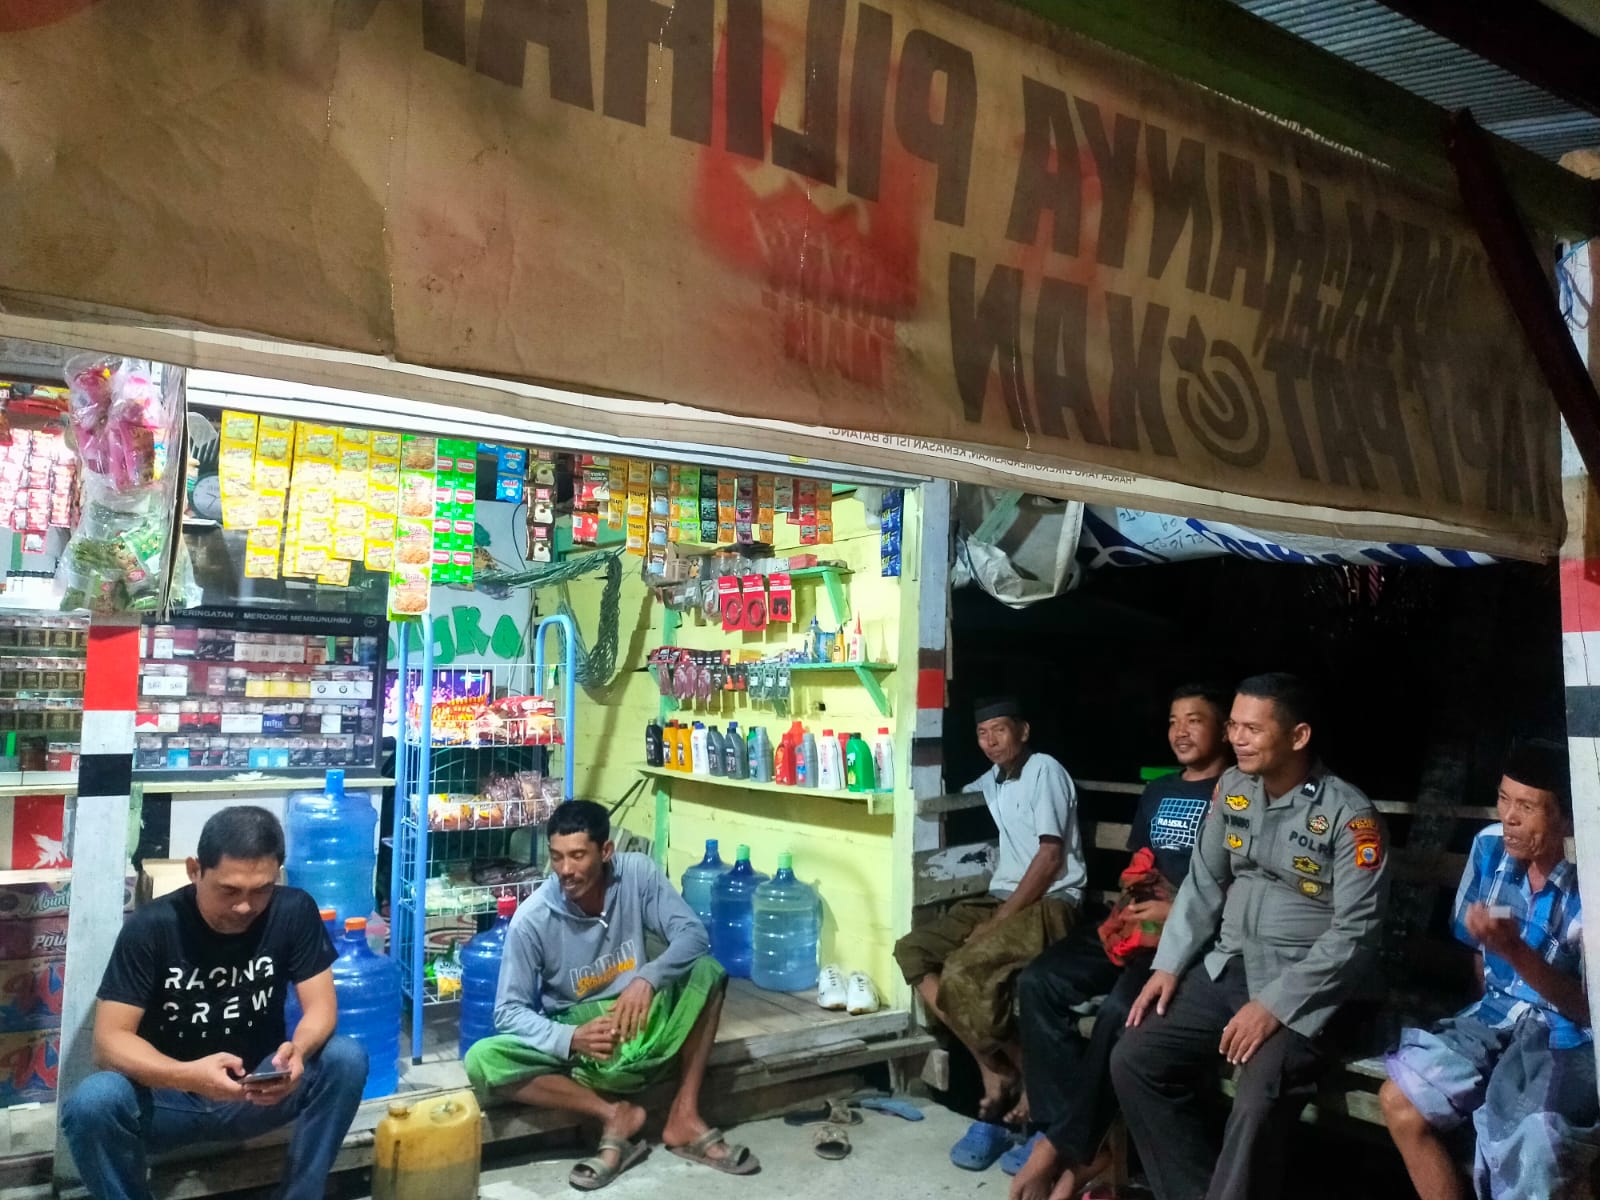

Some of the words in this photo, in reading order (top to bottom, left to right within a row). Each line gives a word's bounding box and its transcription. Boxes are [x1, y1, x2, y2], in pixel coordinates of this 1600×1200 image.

[243, 611, 288, 622] MEROKOK
[290, 613, 352, 625] MEMBUNUHMU
[26, 888, 71, 912] Mount
[32, 932, 67, 950] POW
[164, 956, 274, 990] RACING
[163, 986, 274, 1024] CREW
